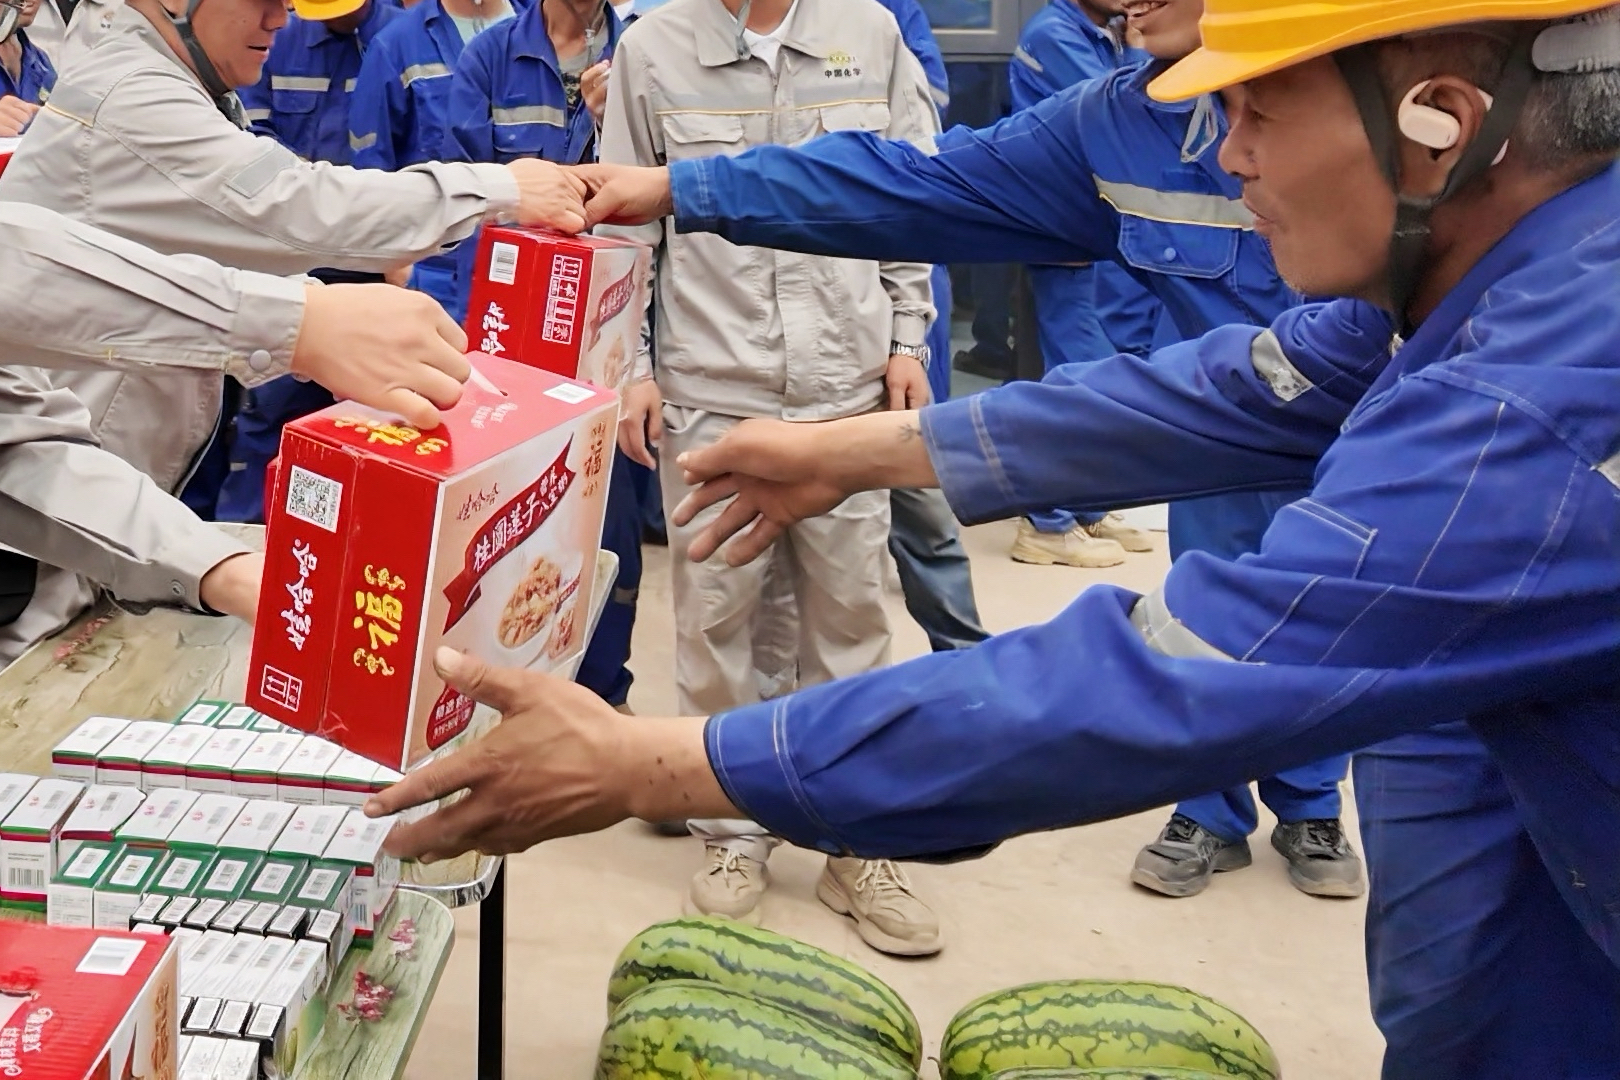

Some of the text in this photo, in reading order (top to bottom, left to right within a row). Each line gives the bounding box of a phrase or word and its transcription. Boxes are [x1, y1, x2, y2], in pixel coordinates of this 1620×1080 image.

[281, 542, 318, 651] 娃哈哈
[353, 580, 403, 650] 福
